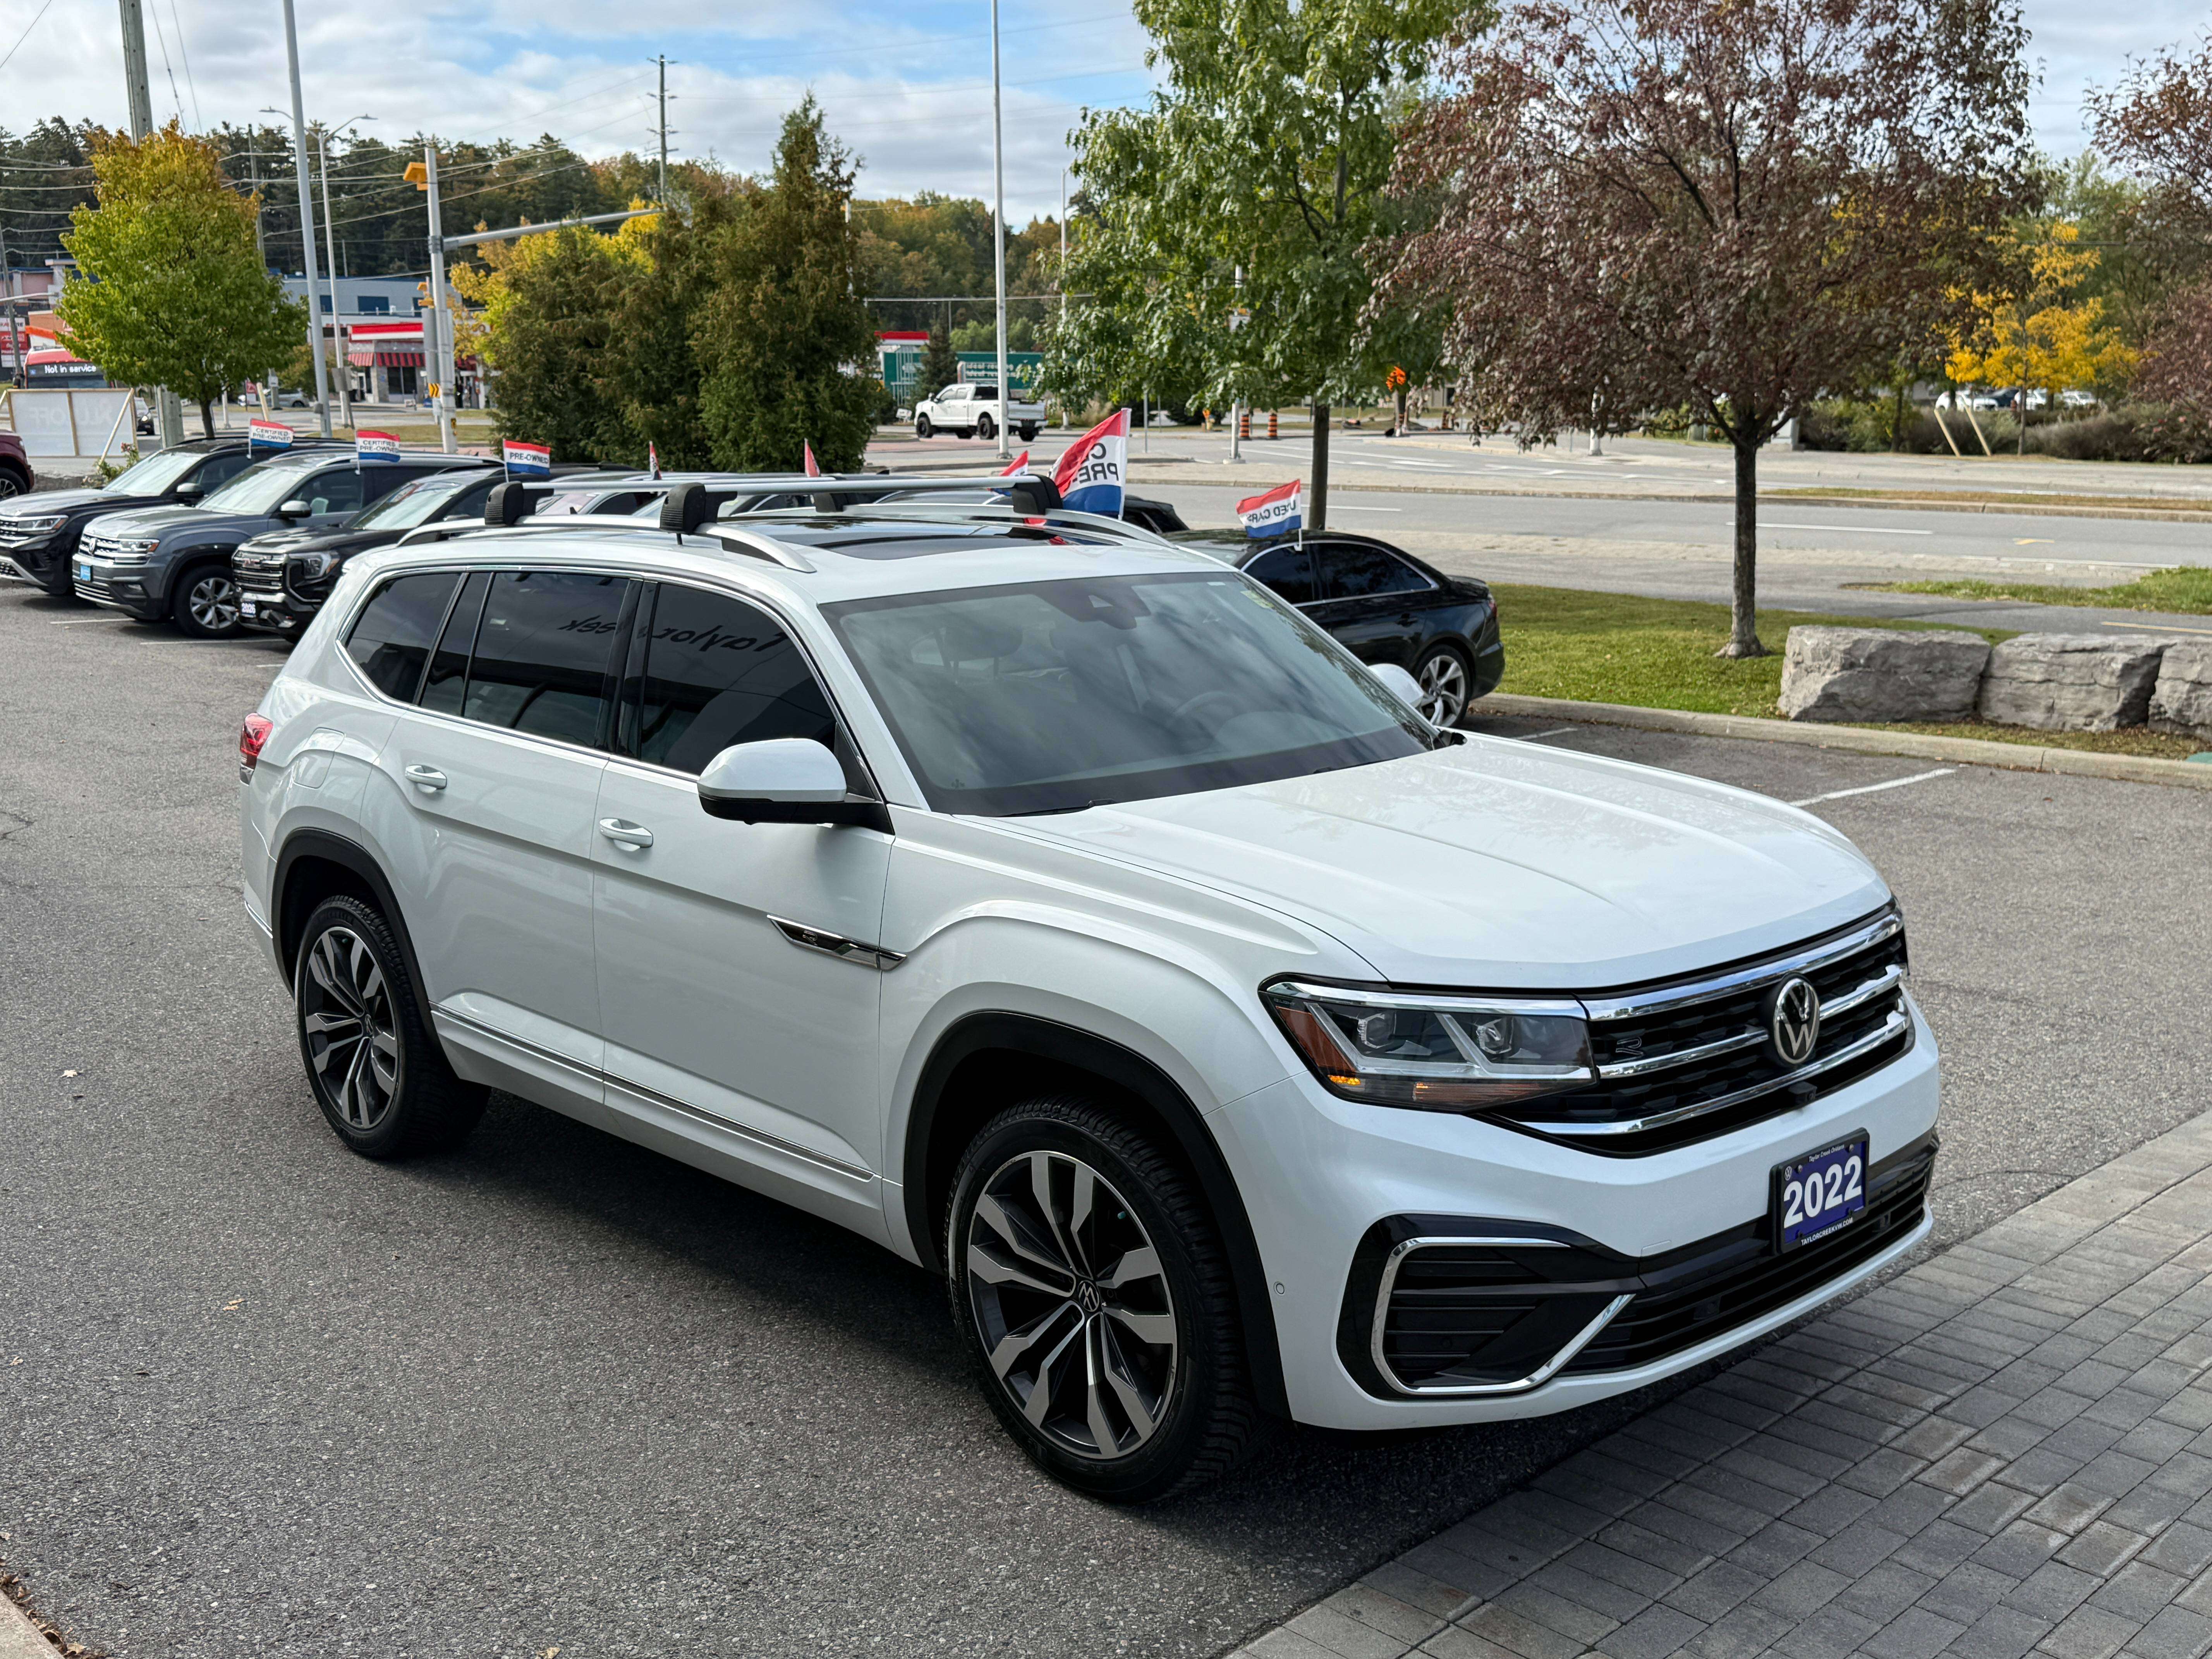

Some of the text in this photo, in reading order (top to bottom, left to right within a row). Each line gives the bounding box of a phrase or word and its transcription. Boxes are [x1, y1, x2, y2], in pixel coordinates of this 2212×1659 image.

[45, 364, 96, 374] Not in service
[253, 433, 291, 441] PRE-OWNED
[256, 428, 288, 436] CERTIFIED
[1809, 1154, 1820, 1162] Taylor
[1820, 1149, 1831, 1158] Creek
[1784, 1155, 1862, 1229] 2022
[1801, 1217, 1853, 1246] TAYLORCREEKVW.COM
